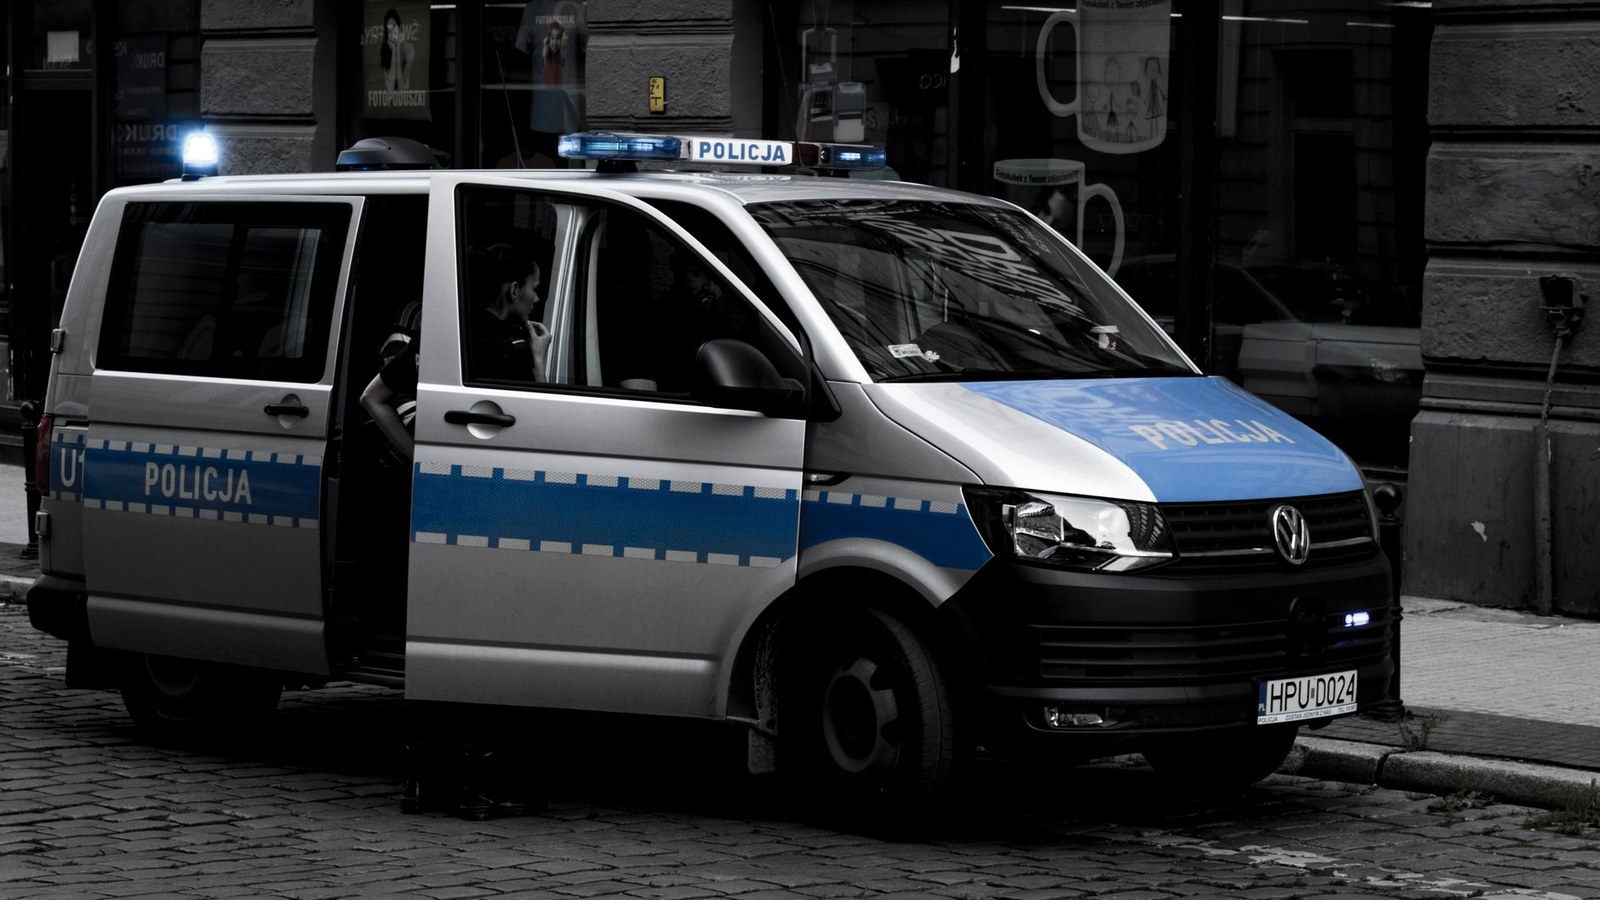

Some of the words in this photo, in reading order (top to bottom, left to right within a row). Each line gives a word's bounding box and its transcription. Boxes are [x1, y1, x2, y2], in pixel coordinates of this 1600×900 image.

[367, 89, 426, 107] FOTOPODUSZKI
[699, 141, 786, 162] POLICJA
[1028, 174, 1047, 184] Twoim
[1127, 418, 1297, 450] POLICJA
[144, 461, 253, 505] POLICJA
[1258, 703, 1266, 712] PL
[1258, 716, 1278, 724] POLICJA
